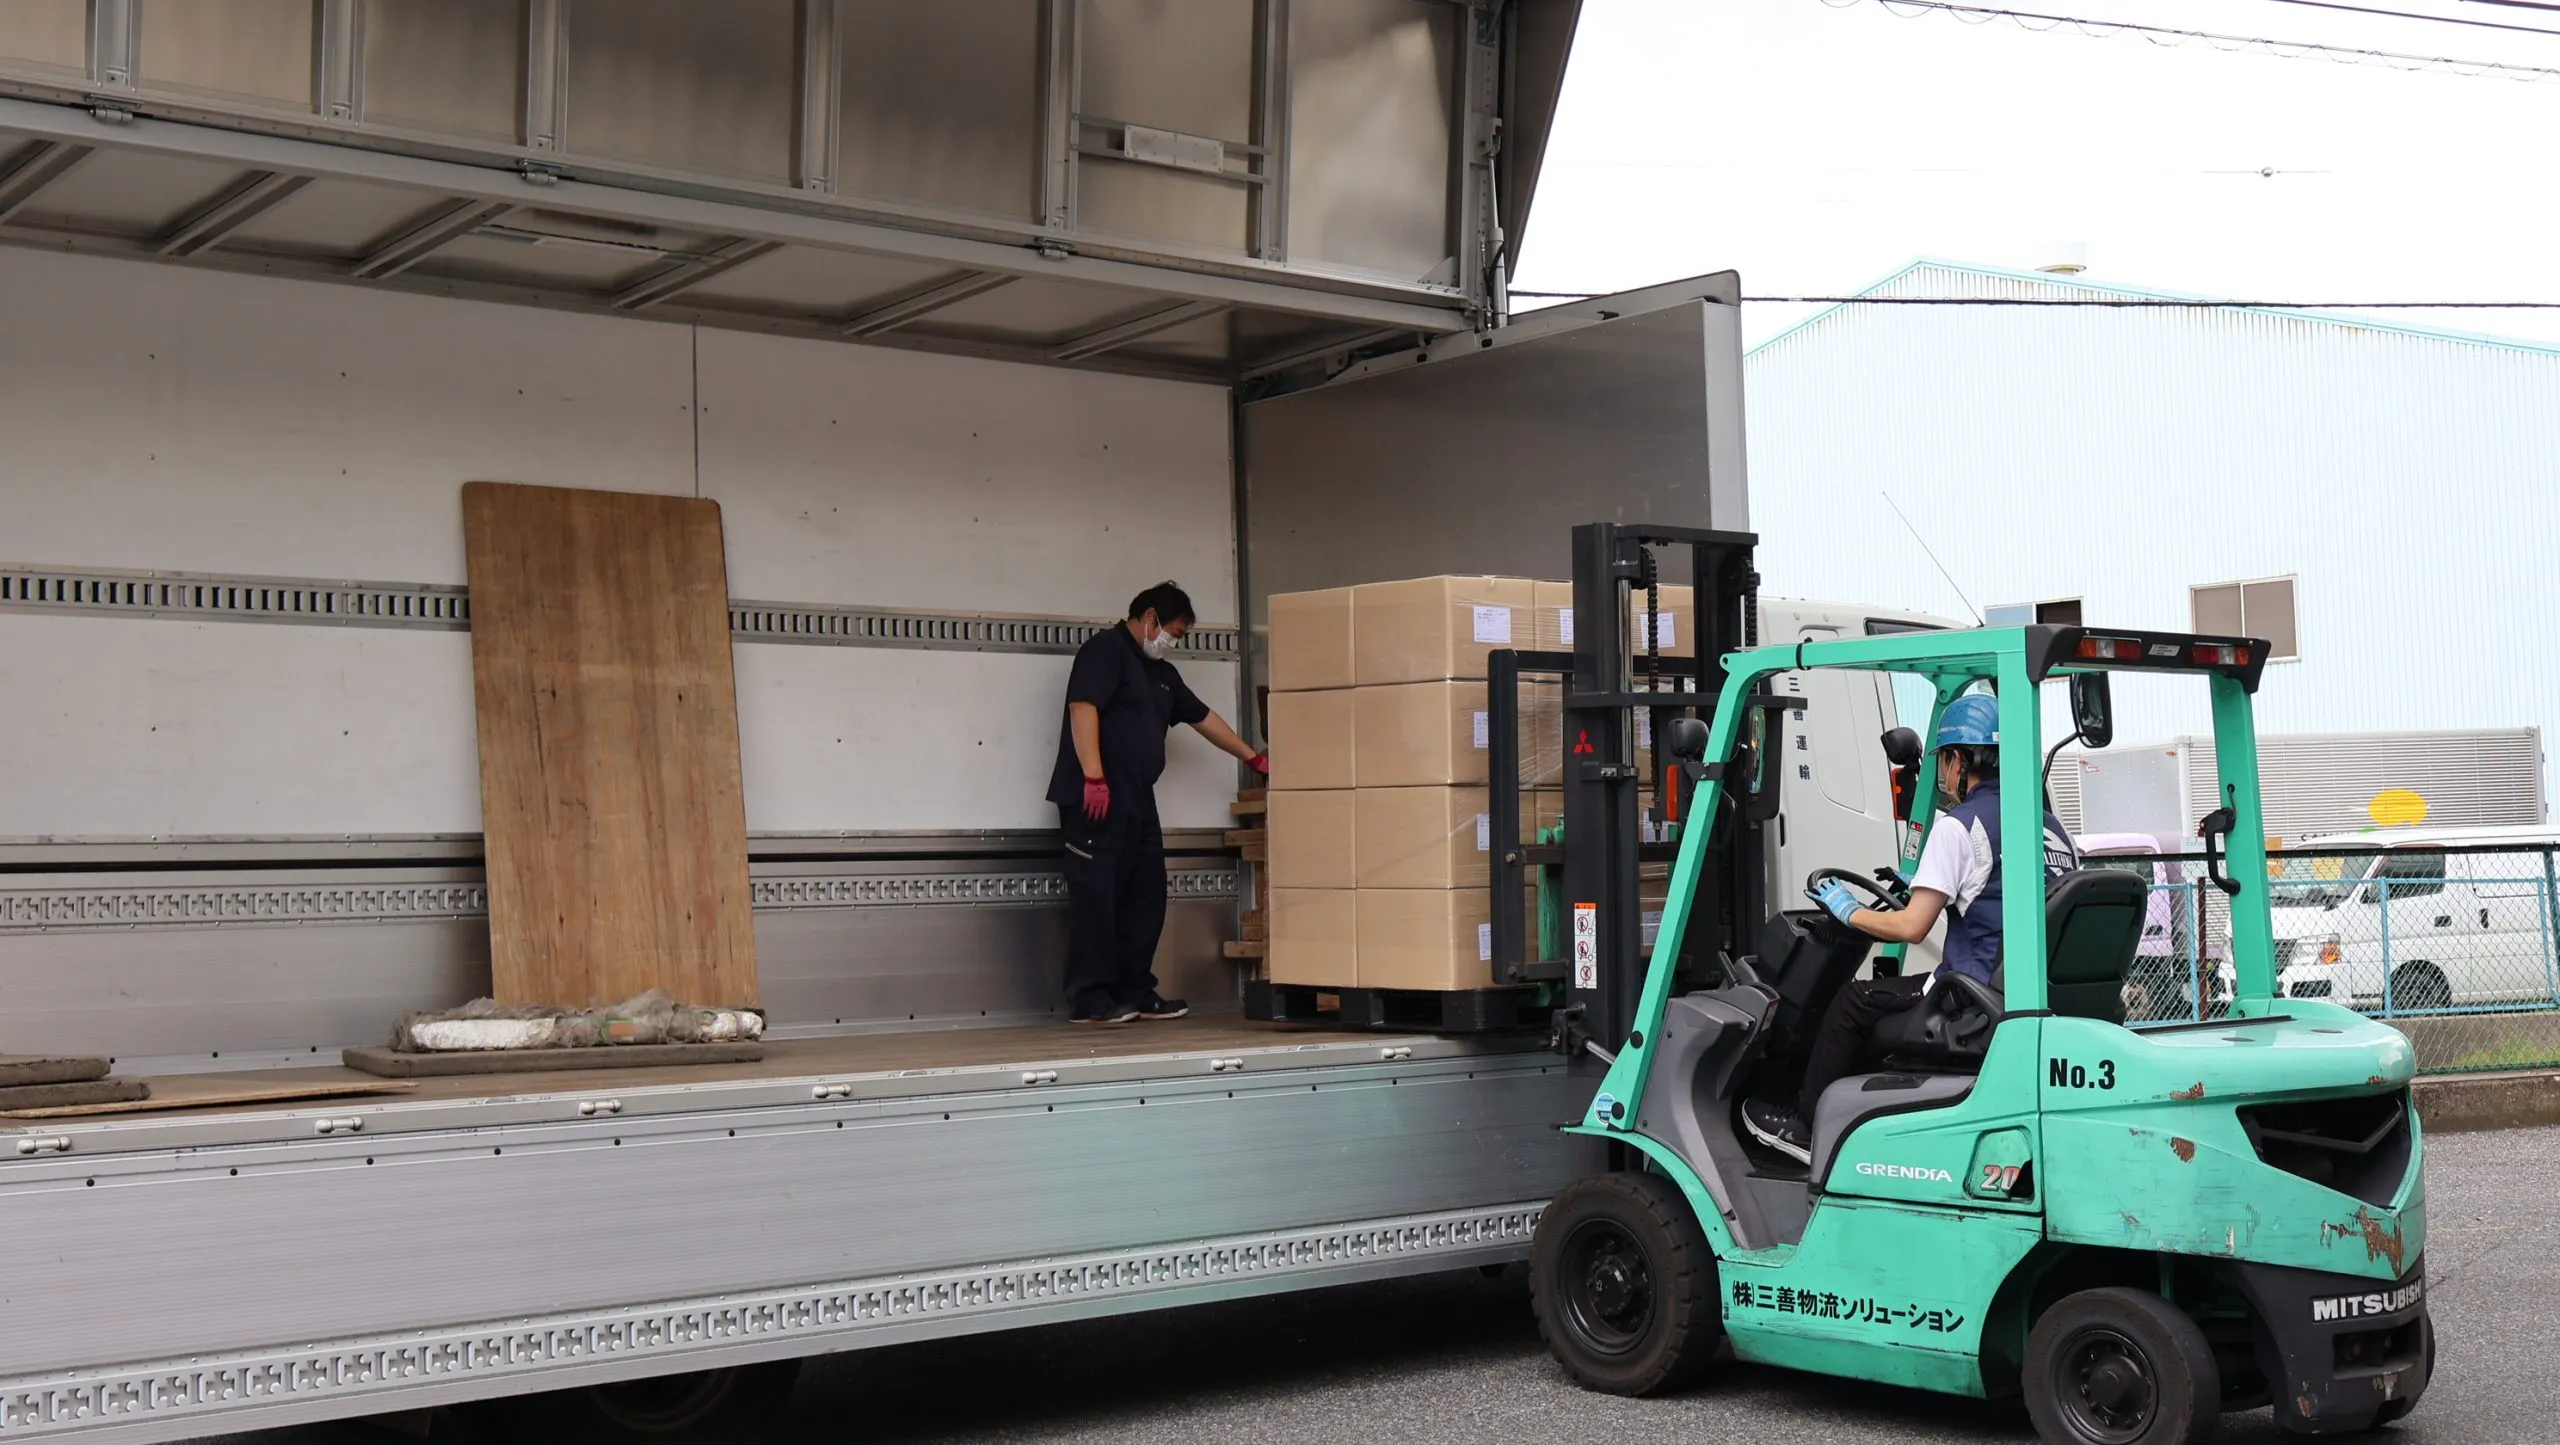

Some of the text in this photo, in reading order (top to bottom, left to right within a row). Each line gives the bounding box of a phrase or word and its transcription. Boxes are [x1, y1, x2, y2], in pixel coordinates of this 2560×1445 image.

[2043, 851, 2074, 869] LUTION
[2049, 1057, 2116, 1090] No.3
[2313, 1279, 2421, 1321] MITSUBISH
